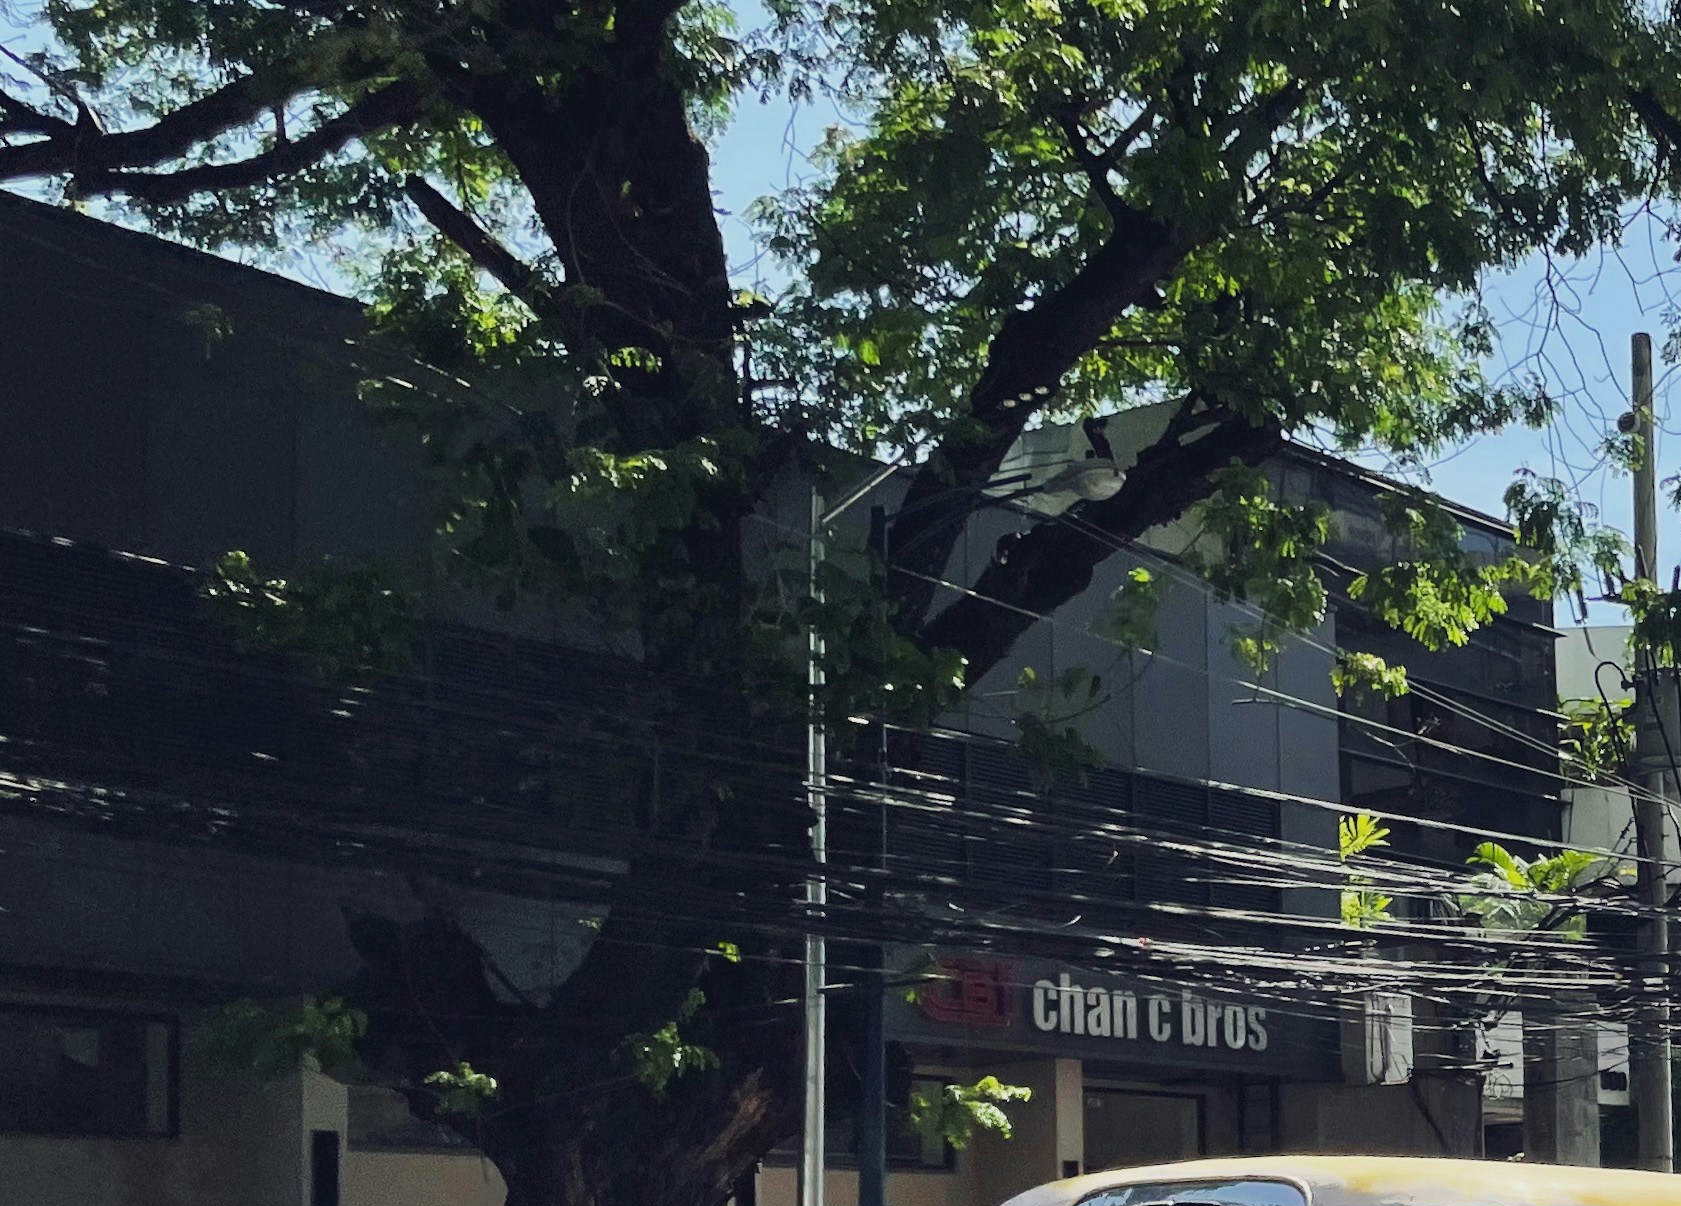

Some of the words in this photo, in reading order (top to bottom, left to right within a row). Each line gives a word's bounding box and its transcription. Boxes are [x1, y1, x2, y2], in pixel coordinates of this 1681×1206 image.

[1033, 973, 1138, 1040] chan
[1150, 993, 1172, 1042] c
[1182, 989, 1268, 1051] bros
